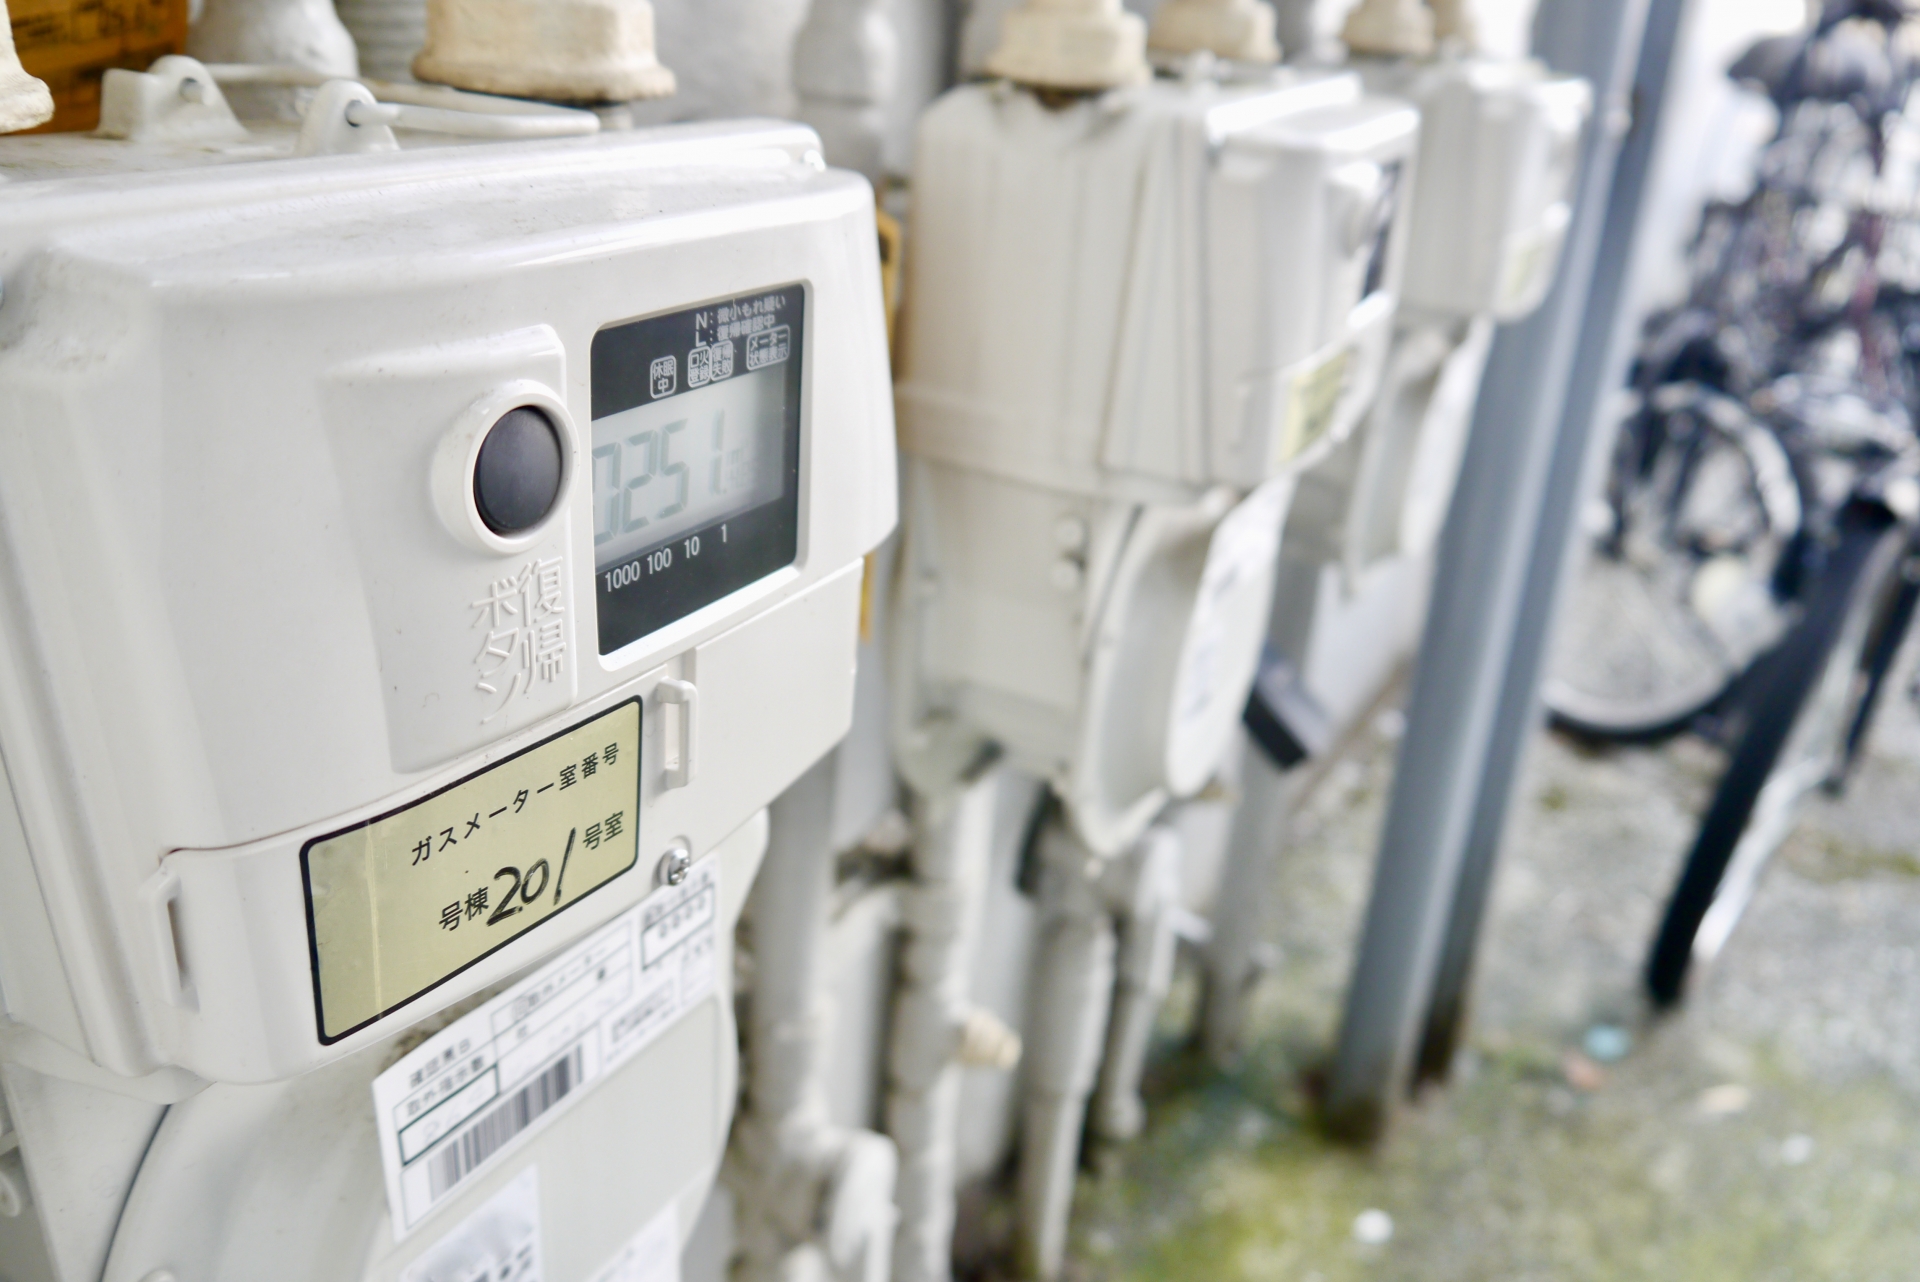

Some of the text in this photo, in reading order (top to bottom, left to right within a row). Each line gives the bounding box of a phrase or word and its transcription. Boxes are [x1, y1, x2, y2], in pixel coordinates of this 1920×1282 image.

[749, 344, 787, 366] 状態表示
[750, 333, 787, 351] メーター
[605, 523, 728, 592] 1000 100 10 1
[469, 575, 521, 725] ボタン
[518, 555, 567, 695] 復帰
[411, 741, 620, 867] ガスメーター室番号
[439, 810, 624, 932] 号棟 201 号室
